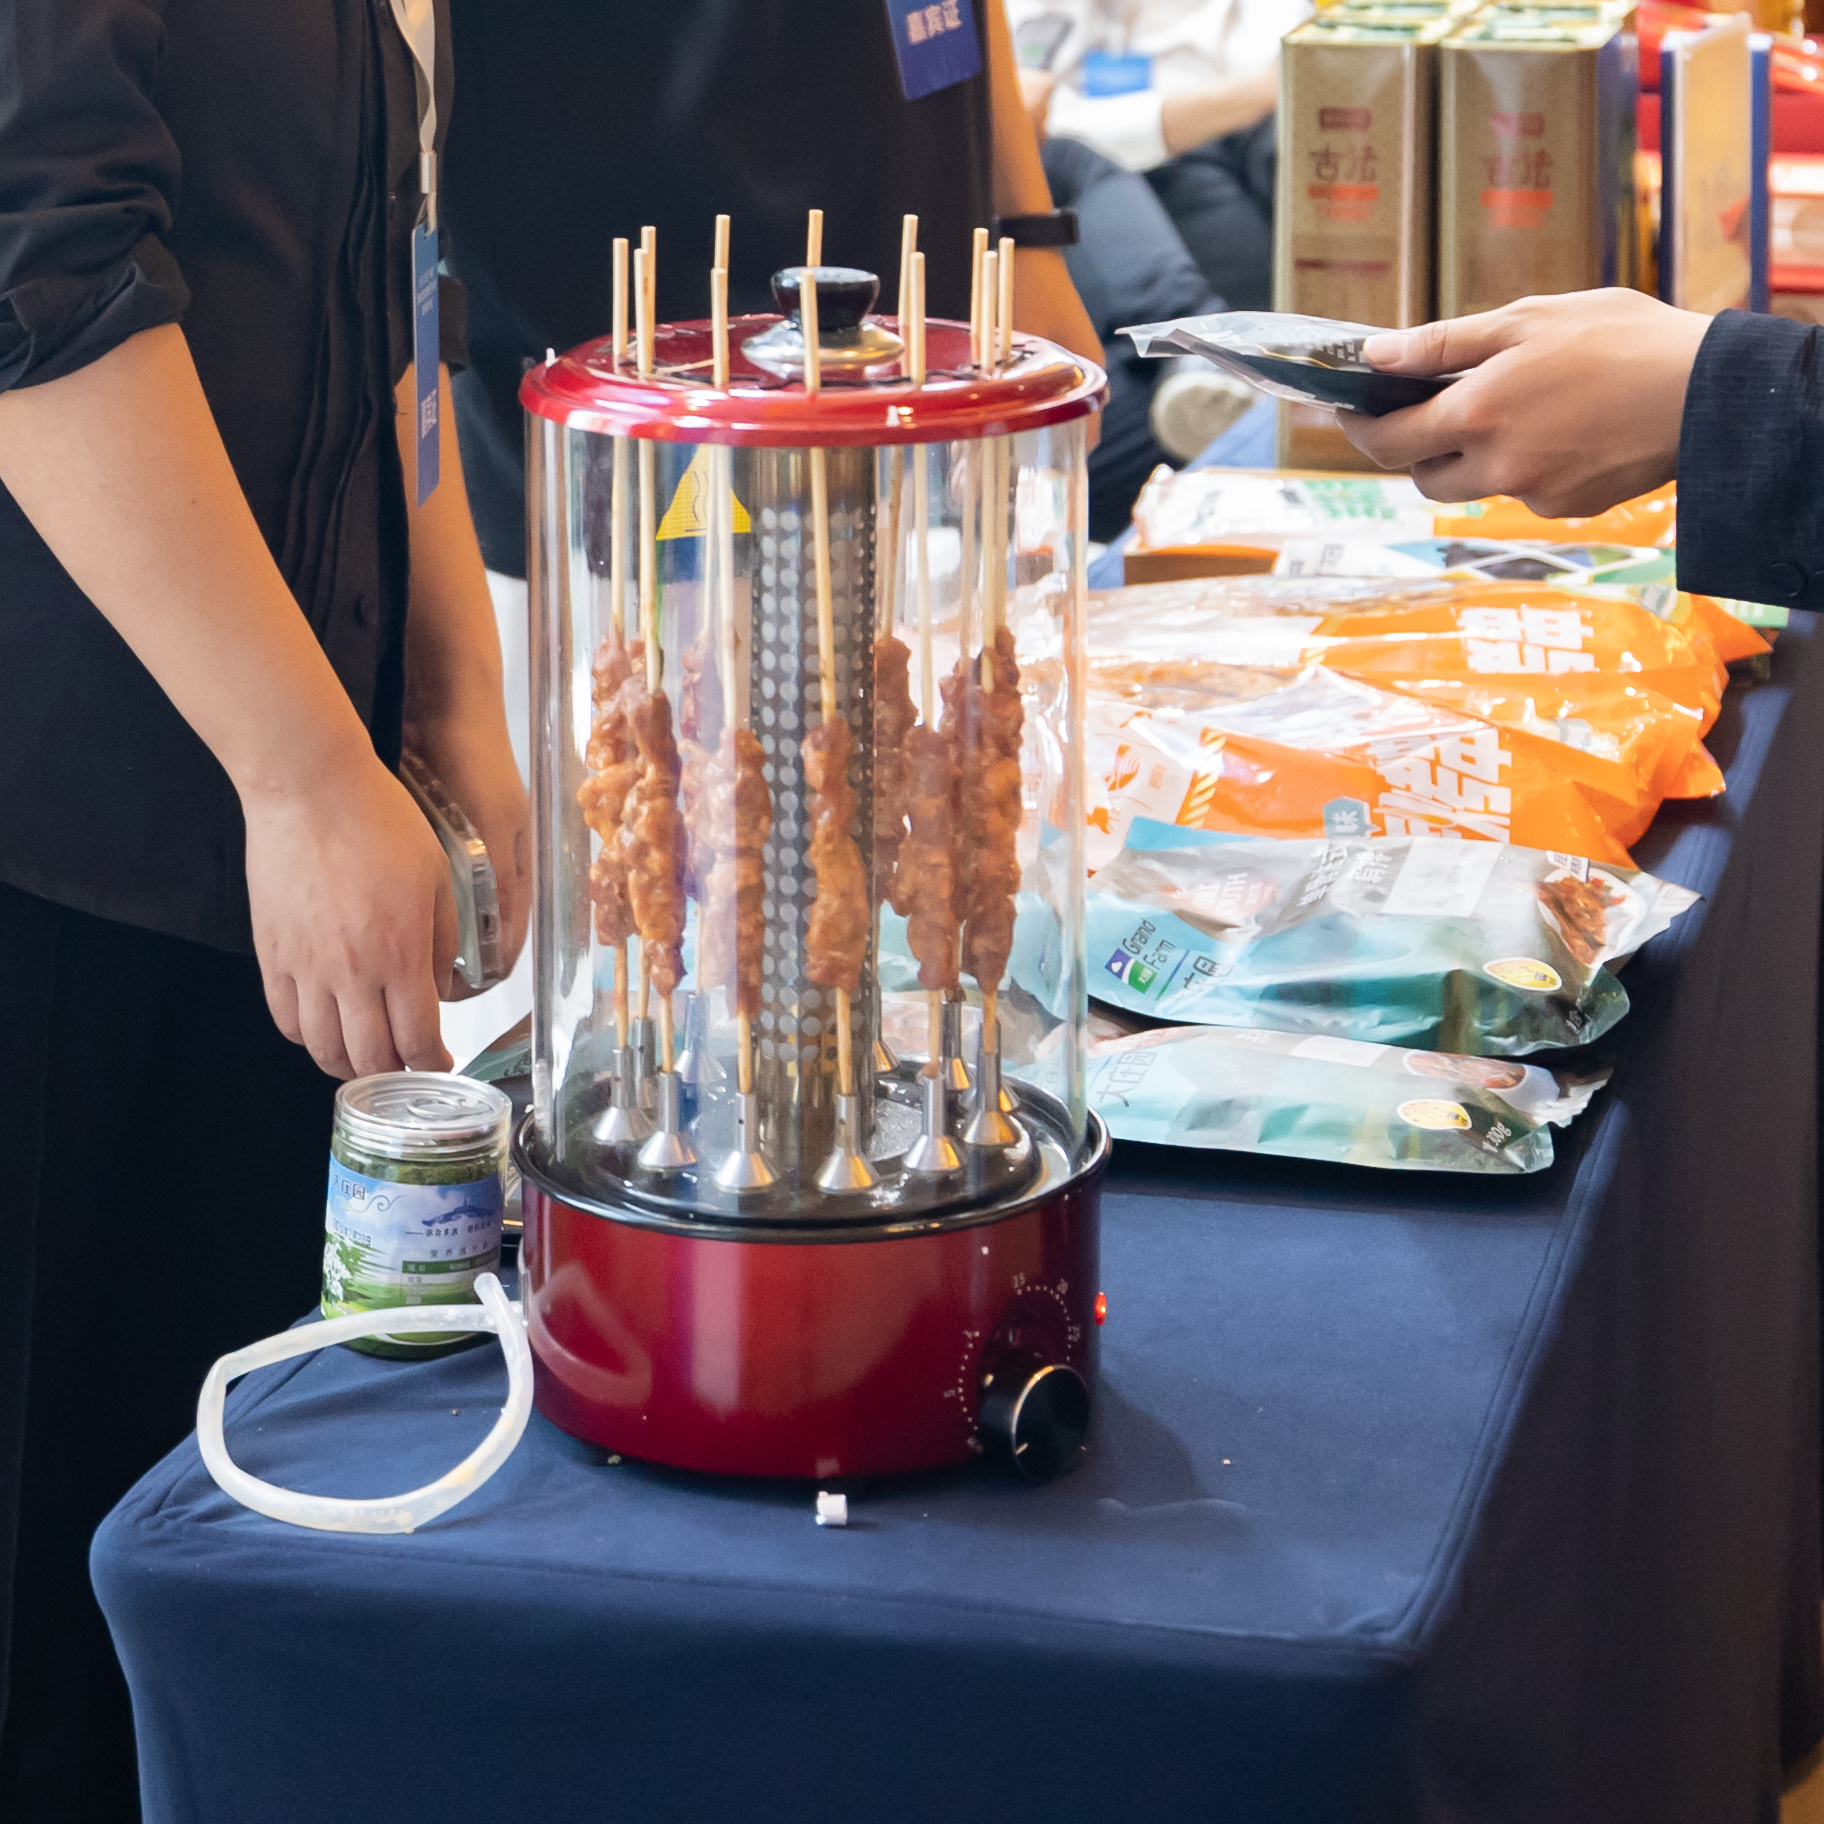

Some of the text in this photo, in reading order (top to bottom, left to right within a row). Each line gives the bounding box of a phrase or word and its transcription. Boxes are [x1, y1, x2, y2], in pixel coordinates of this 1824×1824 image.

[1122, 916, 1158, 956] Grand
[1142, 937, 1178, 971] Farm
[1096, 1048, 1158, 1108] 大庄园
[333, 1174, 366, 1201] 大庄园
